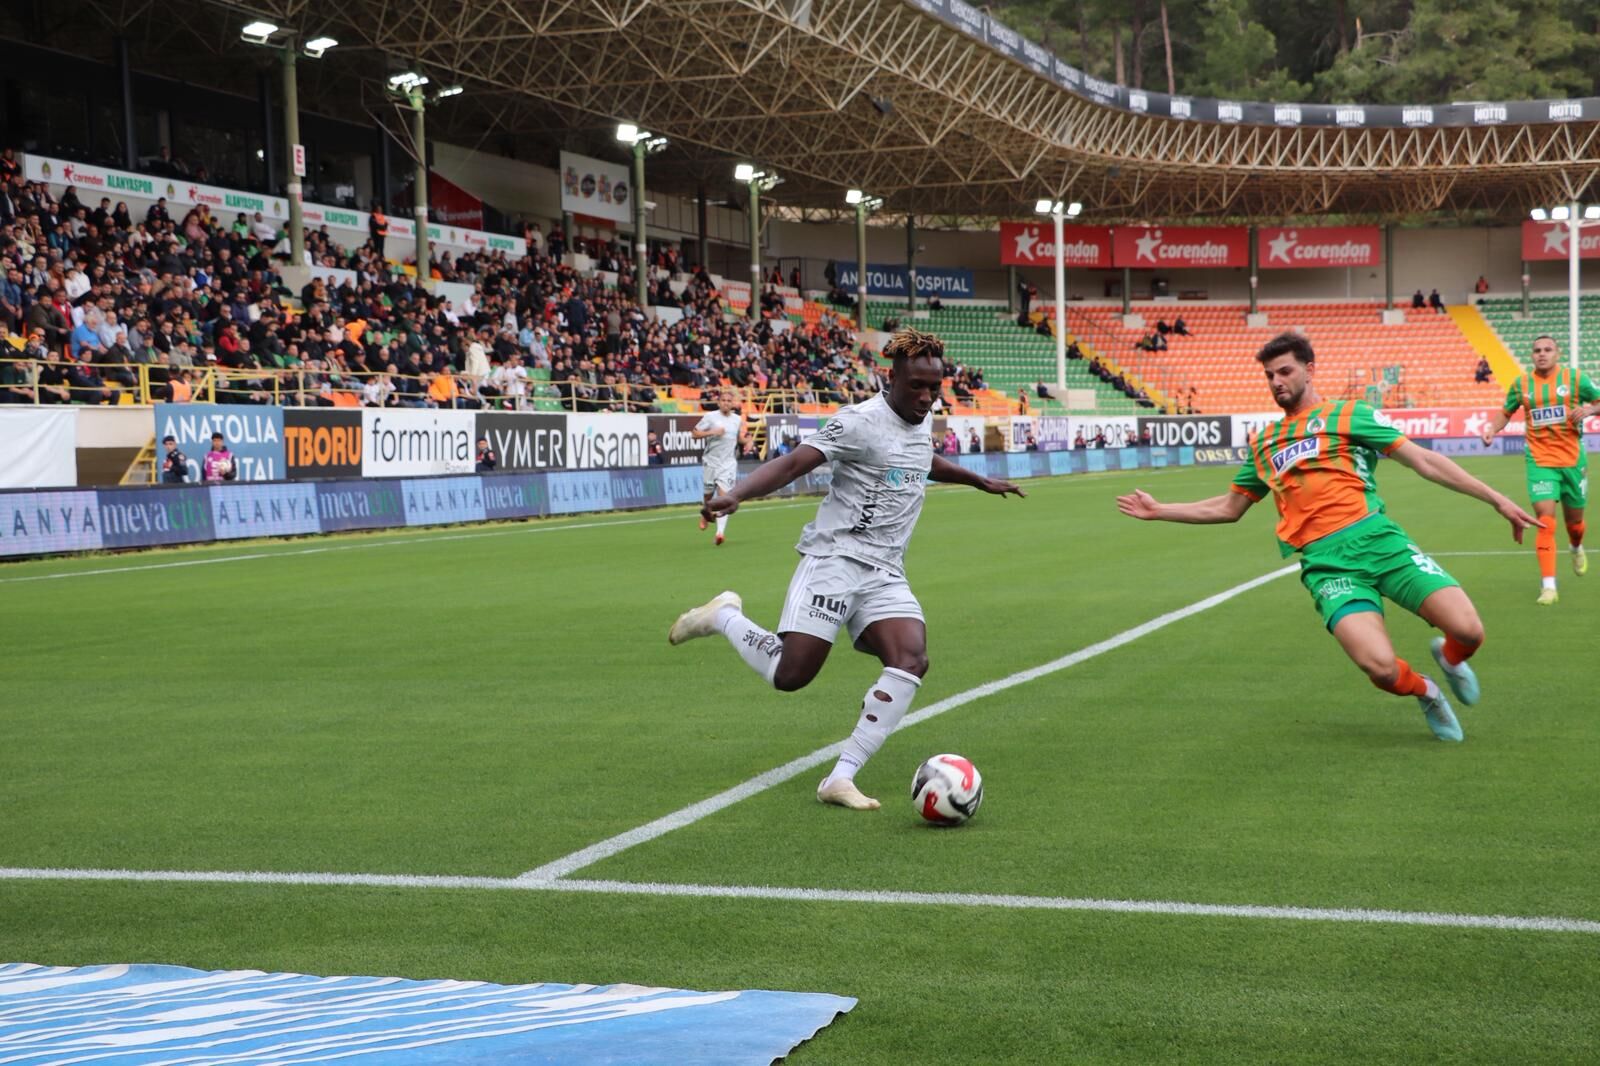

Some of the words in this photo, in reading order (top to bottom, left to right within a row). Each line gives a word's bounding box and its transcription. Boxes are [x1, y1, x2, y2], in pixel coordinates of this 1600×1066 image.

[1474, 107, 1507, 122] MOTTO
[1549, 103, 1582, 118] MOTTO
[107, 174, 152, 195] ALANYASPOR
[1036, 240, 1099, 258] condon
[1158, 240, 1228, 259] corendon
[1294, 240, 1370, 260] corendon
[840, 271, 904, 289] ANTOLIA
[915, 277, 969, 292] OSPITAL
[1533, 407, 1564, 421] TAV
[163, 415, 279, 444] ANATOLIA
[372, 417, 469, 462] formina
[1146, 420, 1221, 446] TUDORS
[284, 426, 361, 467] TBORU
[572, 425, 641, 469] visam
[1273, 438, 1317, 469] TAV
[219, 497, 314, 526] ALANYA
[408, 486, 482, 512] ALANYA
[552, 480, 609, 502] ALANYA
[811, 594, 847, 616] nuh
